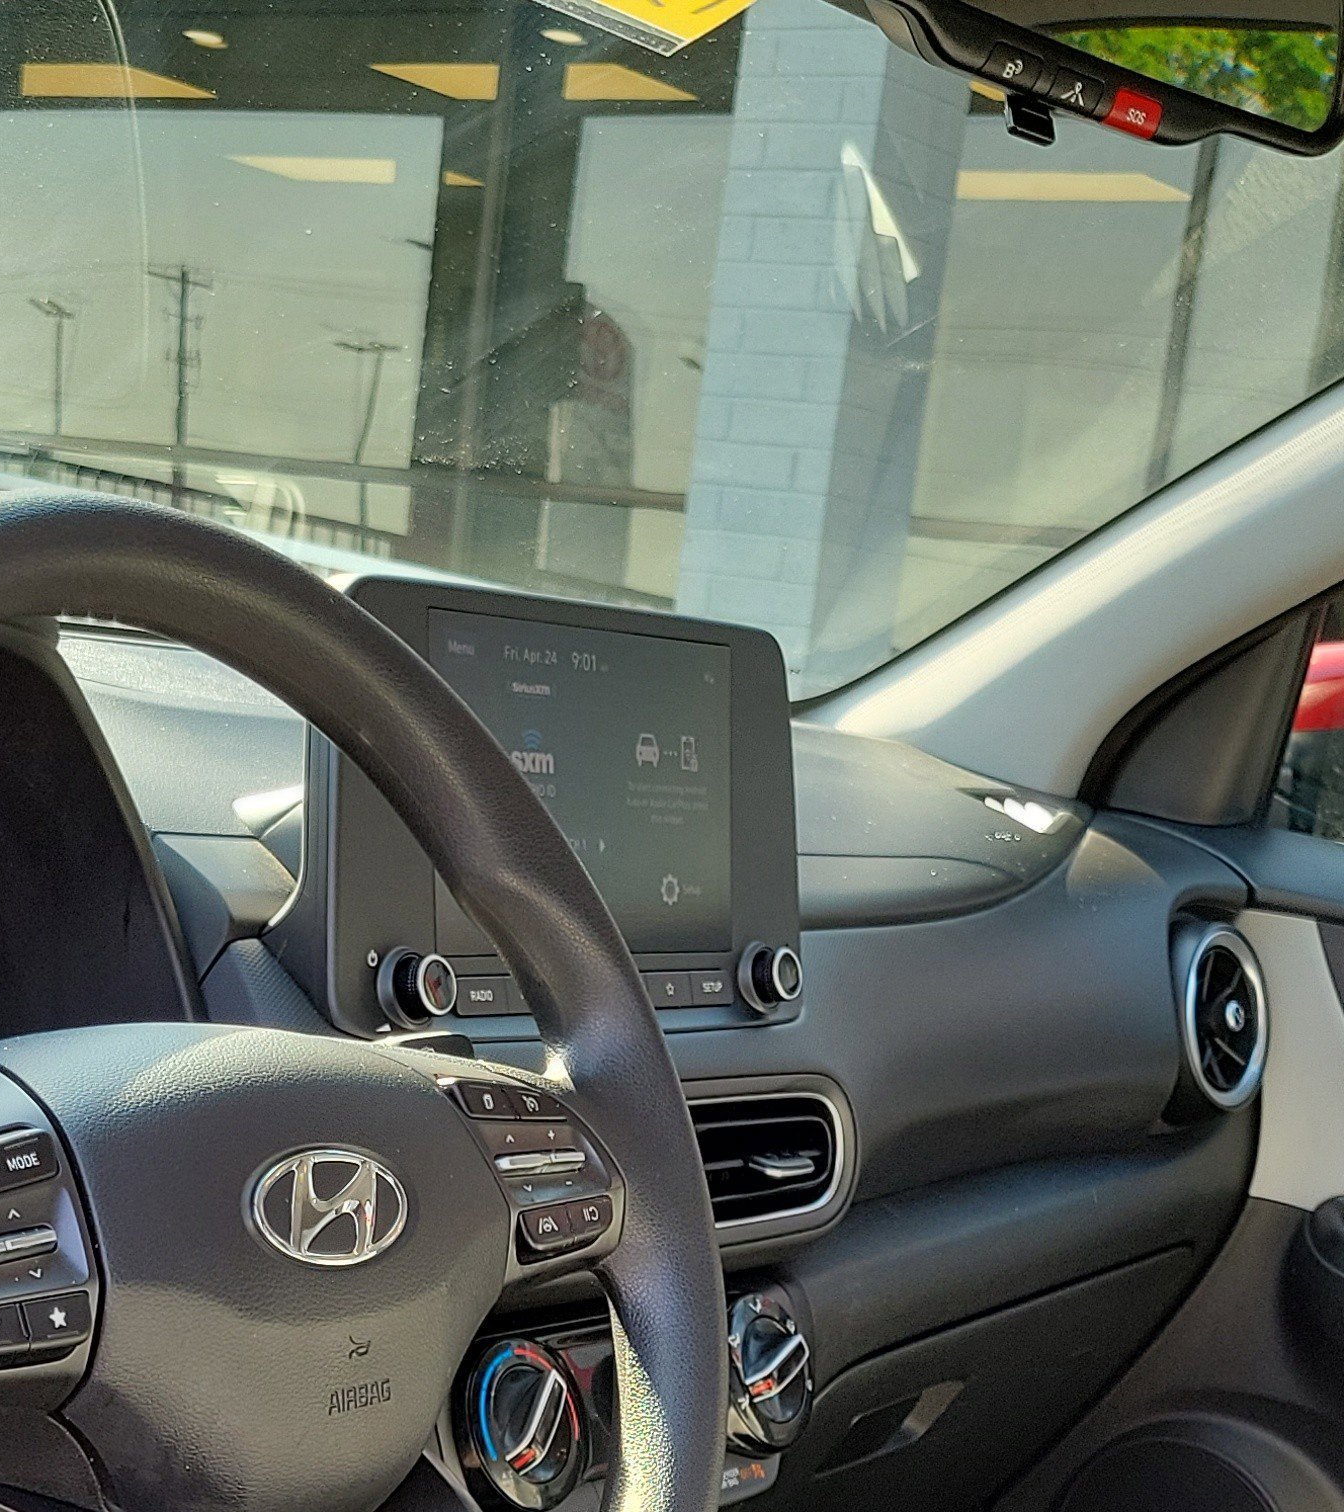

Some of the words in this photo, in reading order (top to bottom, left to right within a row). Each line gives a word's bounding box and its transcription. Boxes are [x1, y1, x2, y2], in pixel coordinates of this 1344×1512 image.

[1126, 108, 1146, 126] SOS
[545, 651, 557, 665] 24
[571, 651, 597, 672] 9:01
[511, 750, 555, 774] sxm
[469, 989, 494, 1002] RADIO
[702, 981, 723, 994] SETUP
[6, 1152, 40, 1172] MODE
[328, 1378, 391, 1416] AIRBAG
